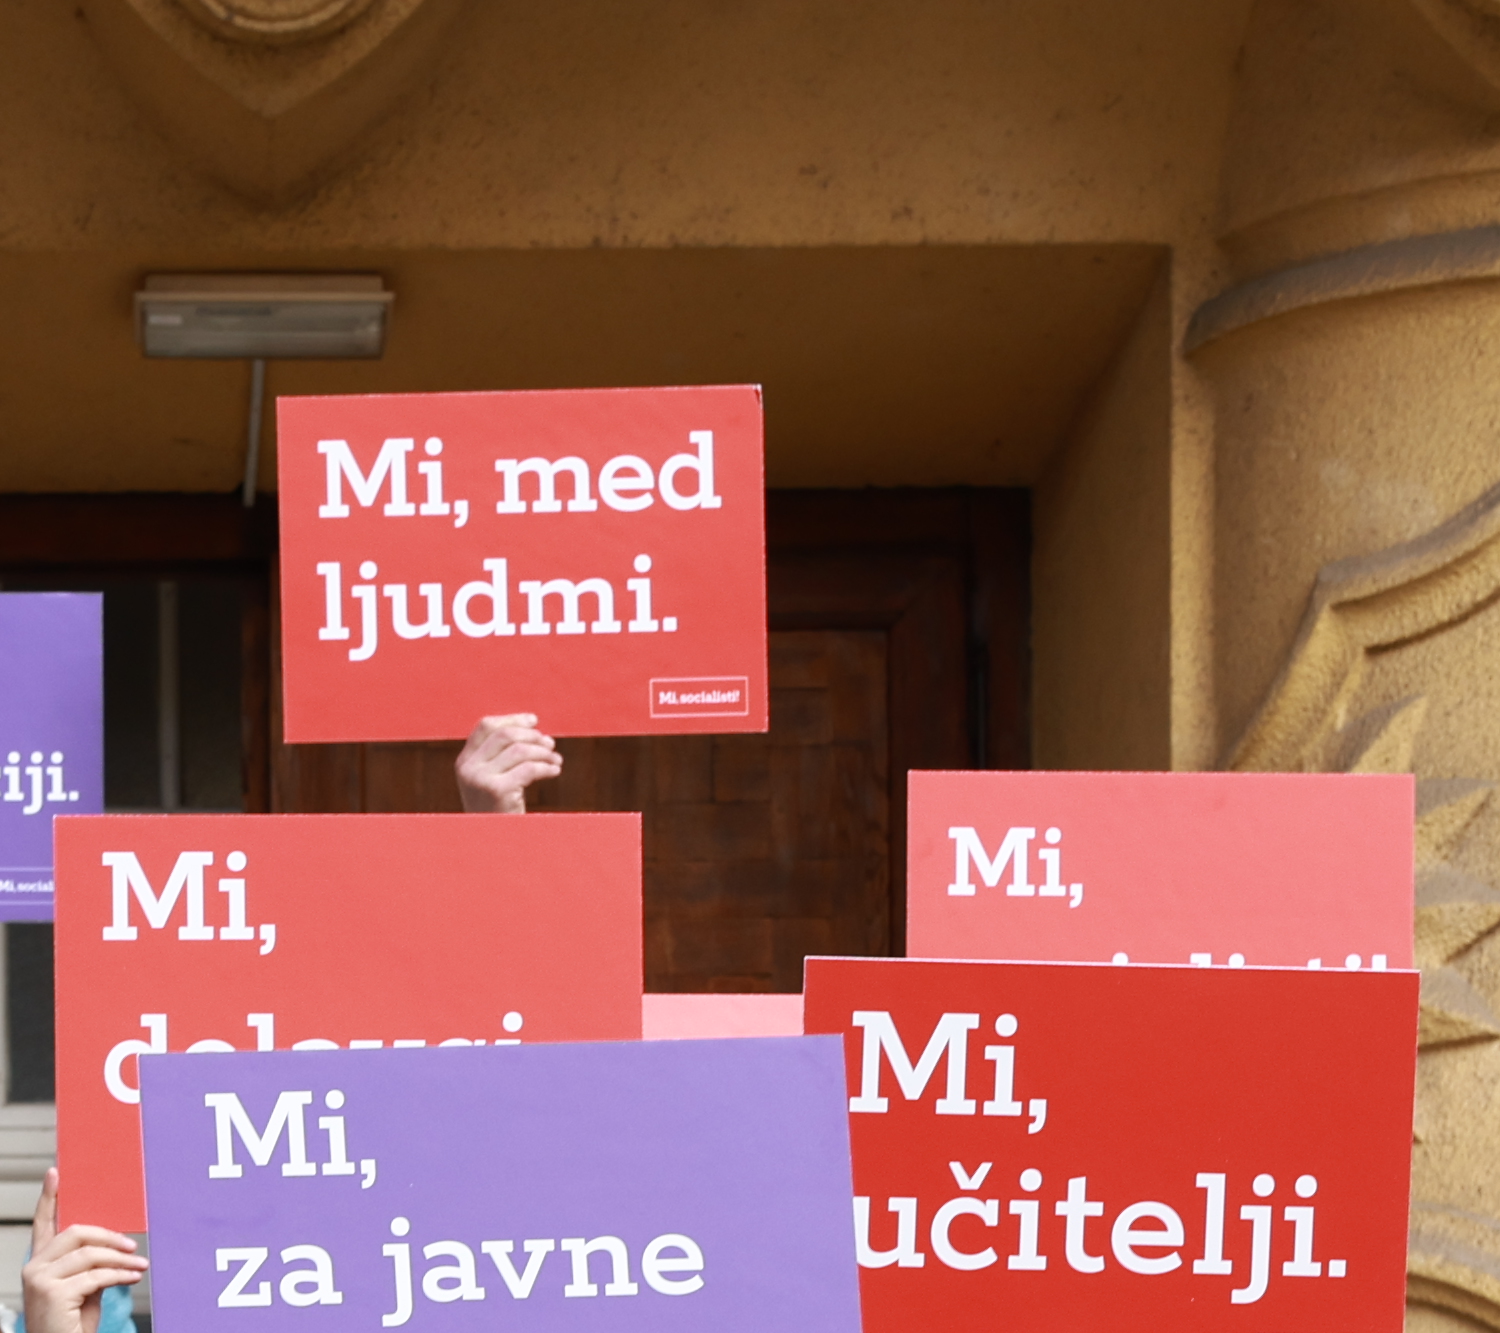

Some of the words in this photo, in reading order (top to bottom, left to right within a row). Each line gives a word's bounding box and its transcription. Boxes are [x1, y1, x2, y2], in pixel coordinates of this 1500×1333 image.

[318, 437, 468, 527] Mi,
[495, 431, 721, 513] med
[317, 554, 677, 661] ljudmi.
[658, 691, 678, 705] Mi,
[679, 689, 741, 704] socialisti!
[17, 880, 53, 892] social
[102, 851, 275, 955] Mi,
[948, 827, 1082, 907] Mi,
[849, 1010, 1047, 1135] Mi,
[205, 1090, 376, 1189] Mi,
[216, 1245, 342, 1307] za
[382, 1217, 704, 1326] javne
[852, 1161, 1347, 1305] učitelji.
